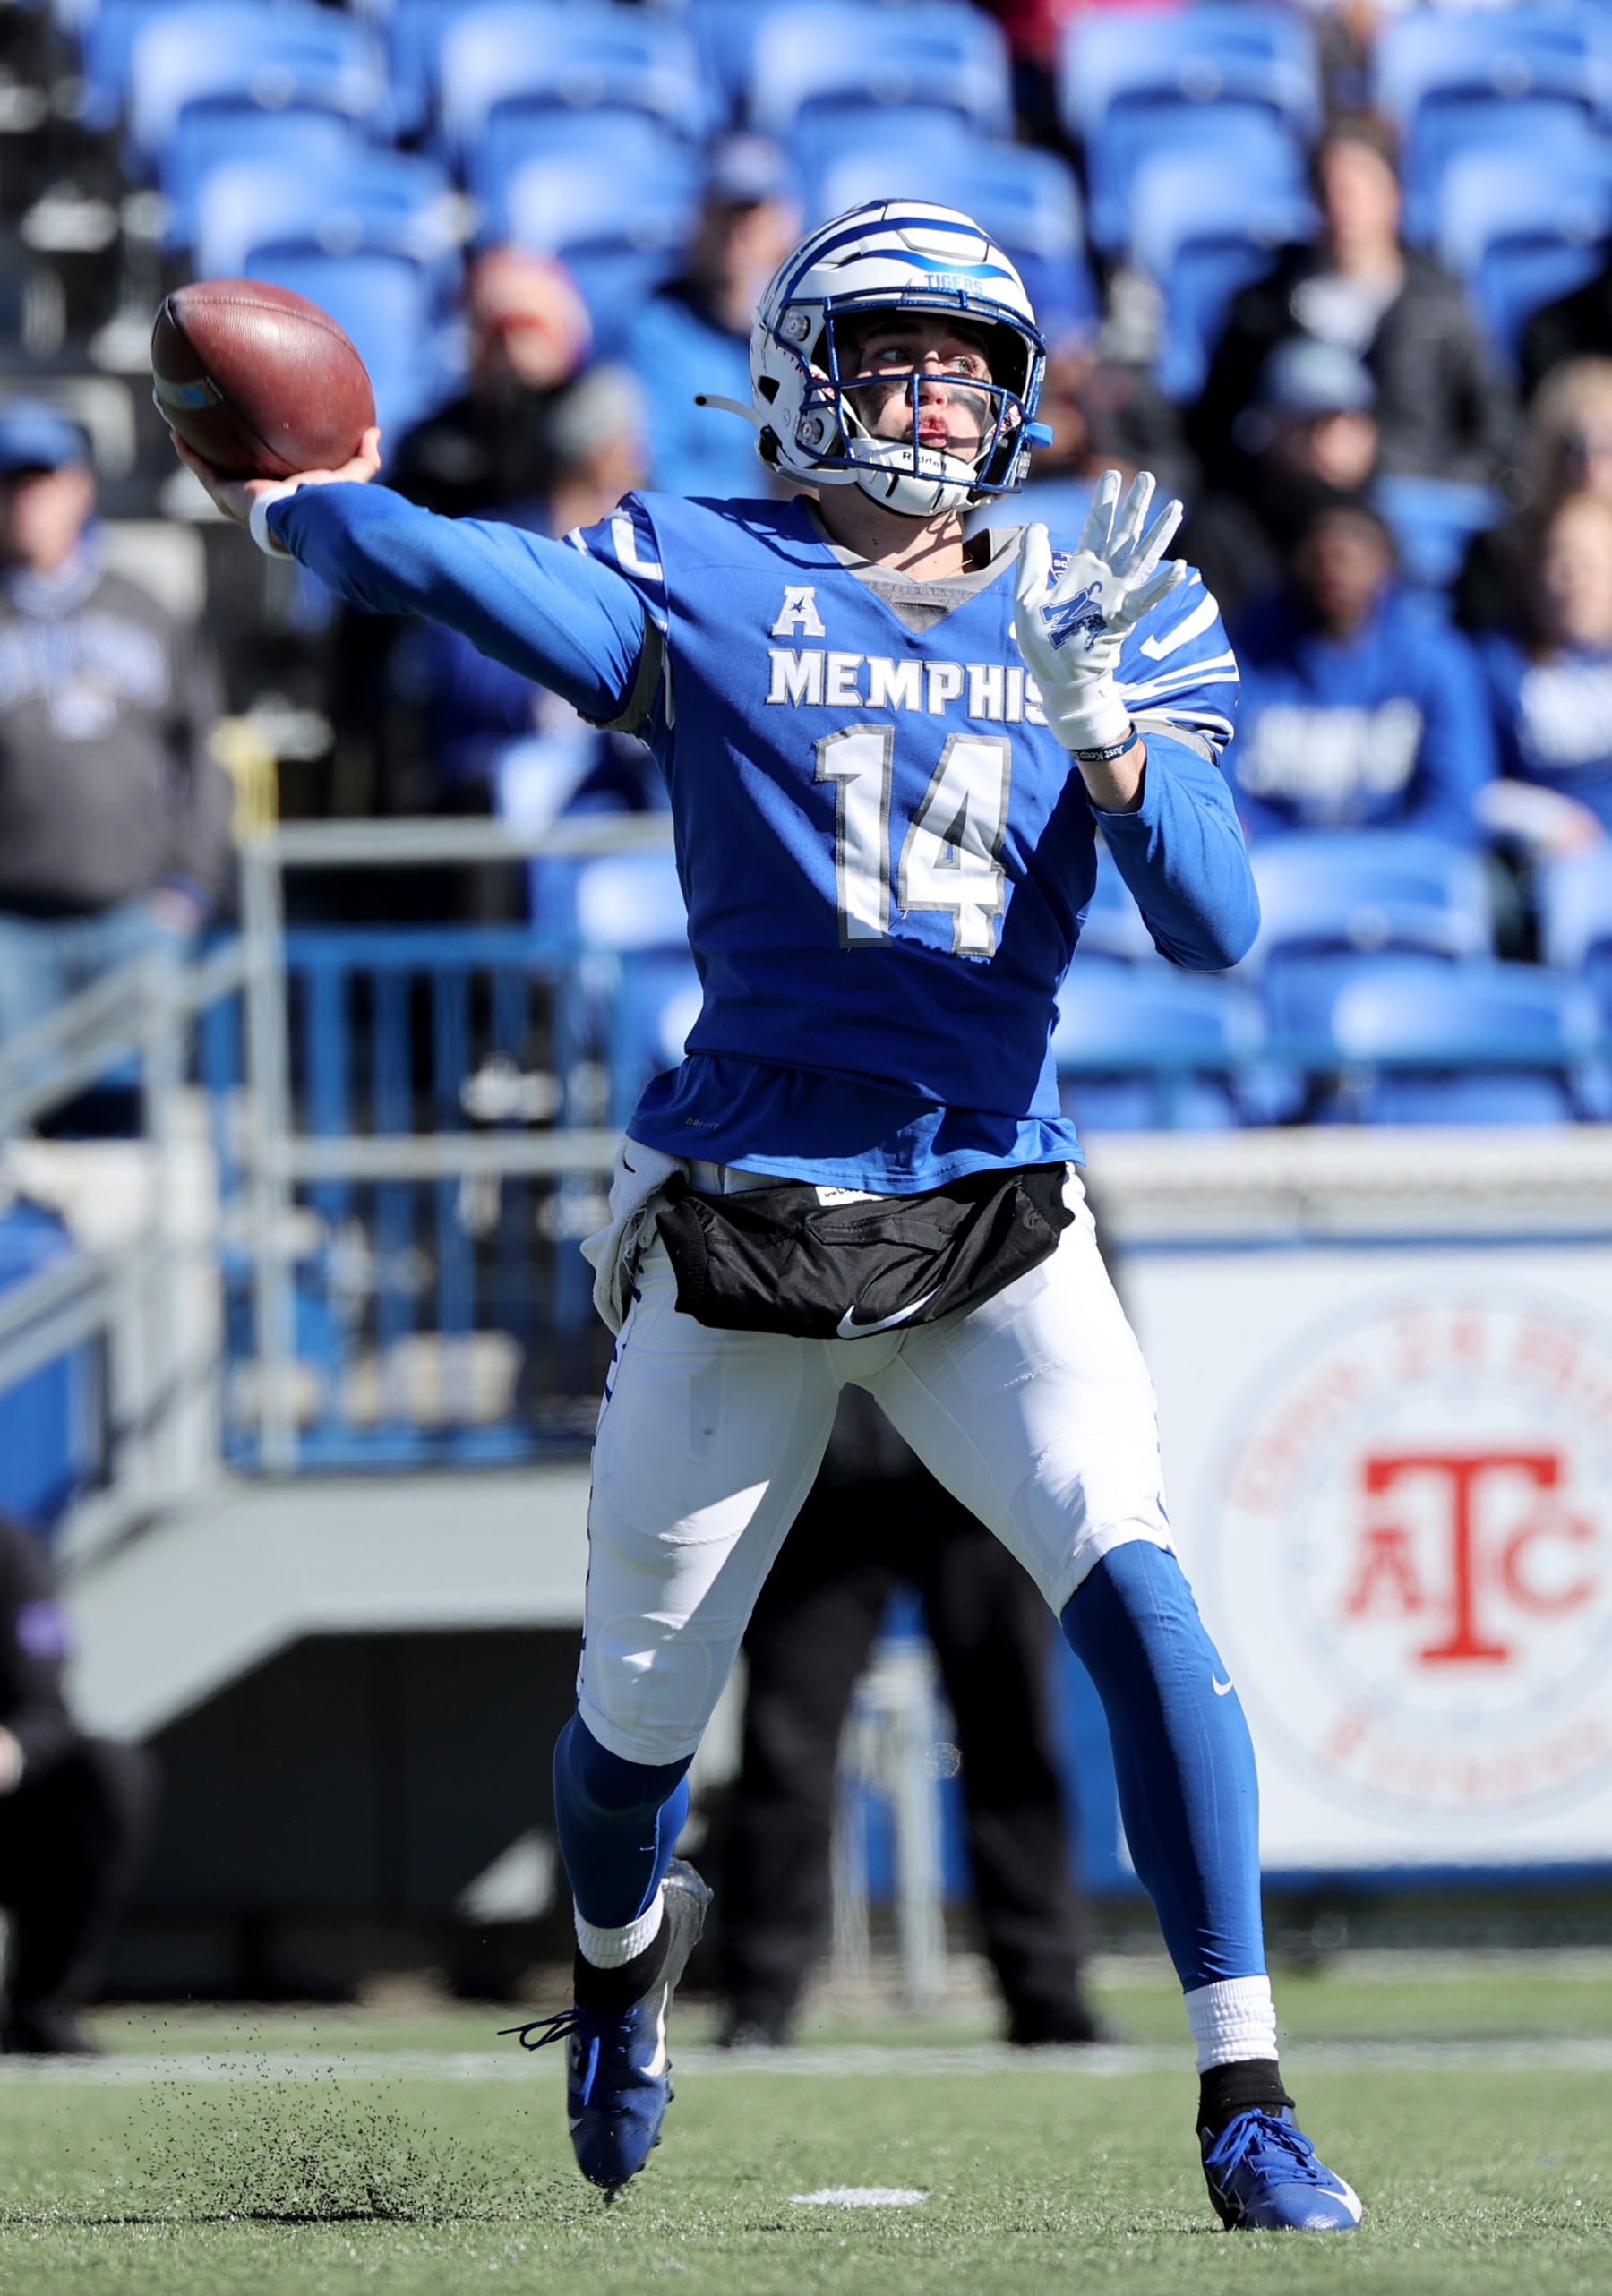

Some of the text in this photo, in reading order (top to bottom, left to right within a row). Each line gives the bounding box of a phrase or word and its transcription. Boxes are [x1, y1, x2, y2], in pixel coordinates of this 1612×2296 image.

[924, 274, 982, 296] TIGERS
[902, 451, 947, 471] Rddell
[766, 648, 1050, 726] MEMPHIS
[1080, 751, 1103, 760] Keep
[1104, 745, 1124, 758] Just
[814, 724, 1012, 958] 14
